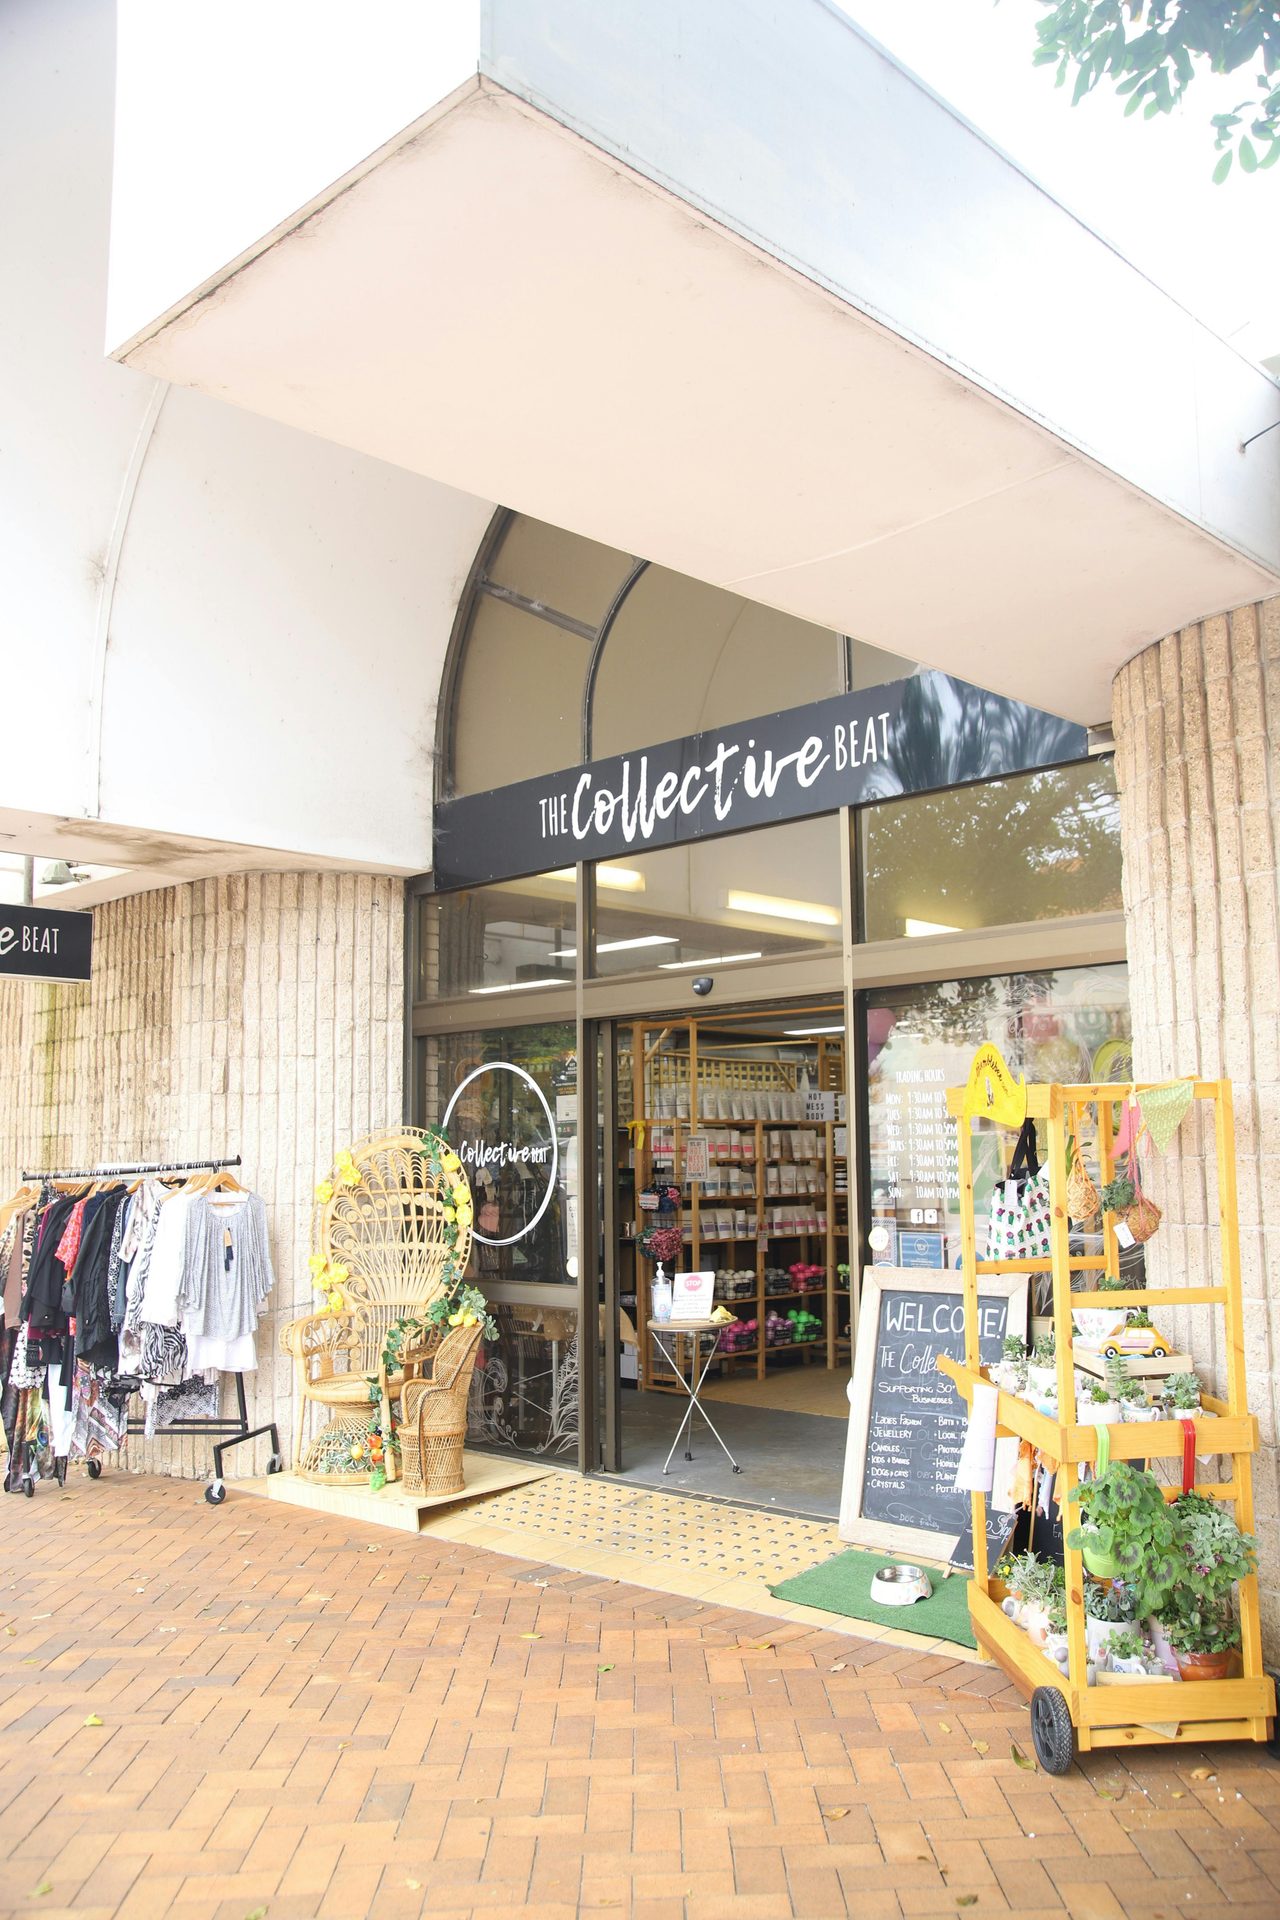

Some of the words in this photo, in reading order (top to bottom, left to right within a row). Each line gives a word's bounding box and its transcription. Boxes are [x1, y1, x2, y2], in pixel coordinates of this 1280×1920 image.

[539, 794, 568, 838] THE
[572, 736, 830, 842] Collective
[834, 712, 890, 771] BEAT
[22, 925, 60, 954] BEAT
[896, 1070, 923, 1083] TRADING
[924, 1068, 945, 1081] HOURS
[885, 1093, 903, 1105] MON:
[886, 1122, 902, 1135] WED:
[909, 1122, 933, 1135] 9:30AM
[935, 1122, 943, 1134] TO
[909, 1138, 934, 1151] 9:30AM
[936, 1139, 944, 1150] TO
[461, 1140, 532, 1168] Collective
[532, 1148, 548, 1163] BEAT
[910, 1154, 935, 1167] 9:30AM
[936, 1155, 944, 1167] TO
[887, 1170, 901, 1183] SAT:
[910, 1170, 935, 1183] 9:30AM
[936, 1170, 944, 1182] TO
[887, 1186, 904, 1199] SUN:
[915, 1186, 935, 1199] 10AM
[936, 1186, 944, 1198] TO
[886, 1301, 1007, 1339] WELCOE!
[880, 1345, 896, 1368] THE
[873, 1427, 912, 1439] JEWELLERY
[871, 1442, 900, 1453] CANDLES
[935, 1471, 956, 1481] PLANT
[871, 1479, 905, 1489] CRYSTALS
[900, 1513, 914, 1523] DOG
